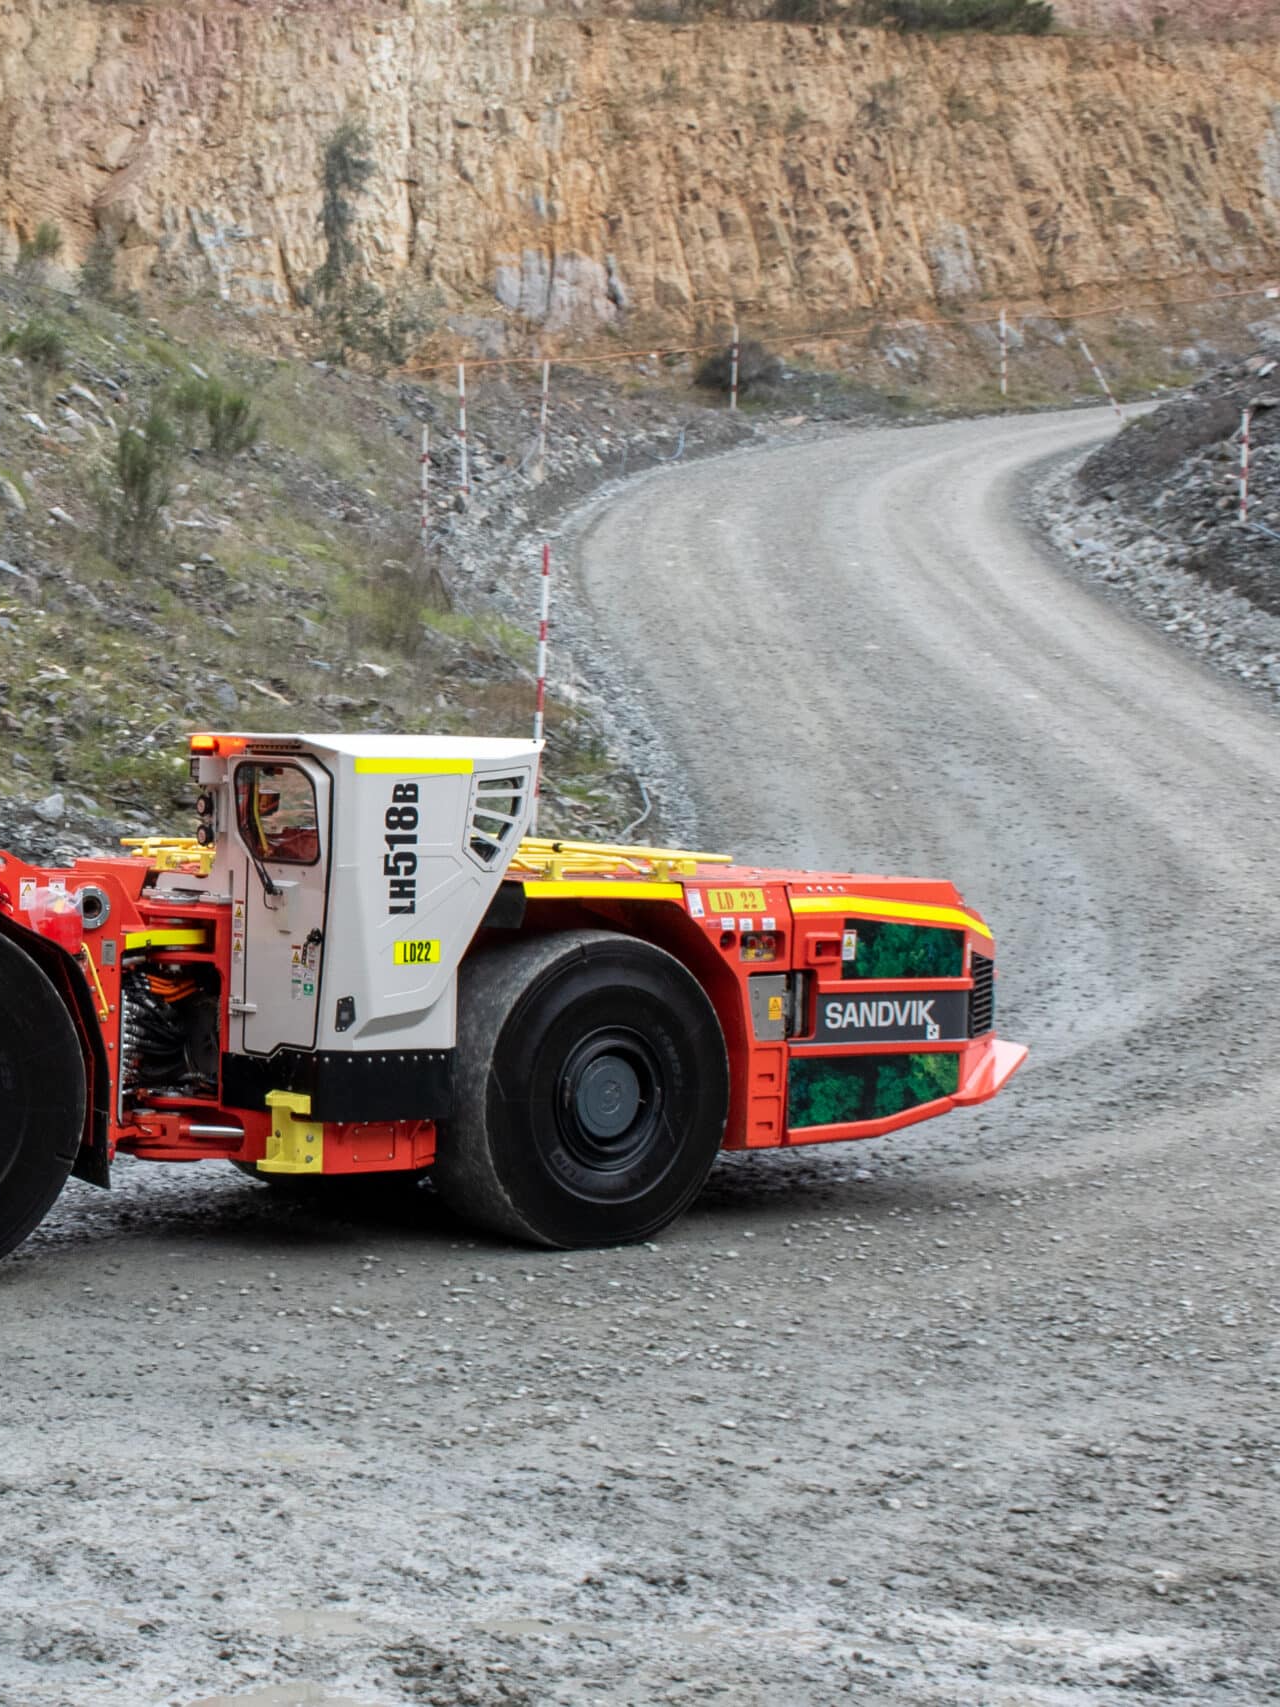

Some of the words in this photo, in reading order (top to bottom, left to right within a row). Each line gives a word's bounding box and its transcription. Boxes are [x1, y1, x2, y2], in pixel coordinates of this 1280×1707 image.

[383, 783, 419, 915] LH518B
[716, 891, 734, 910] LD
[740, 891, 758, 909] 22
[403, 941, 432, 963] LD22
[825, 1000, 936, 1029] SANDVIK
